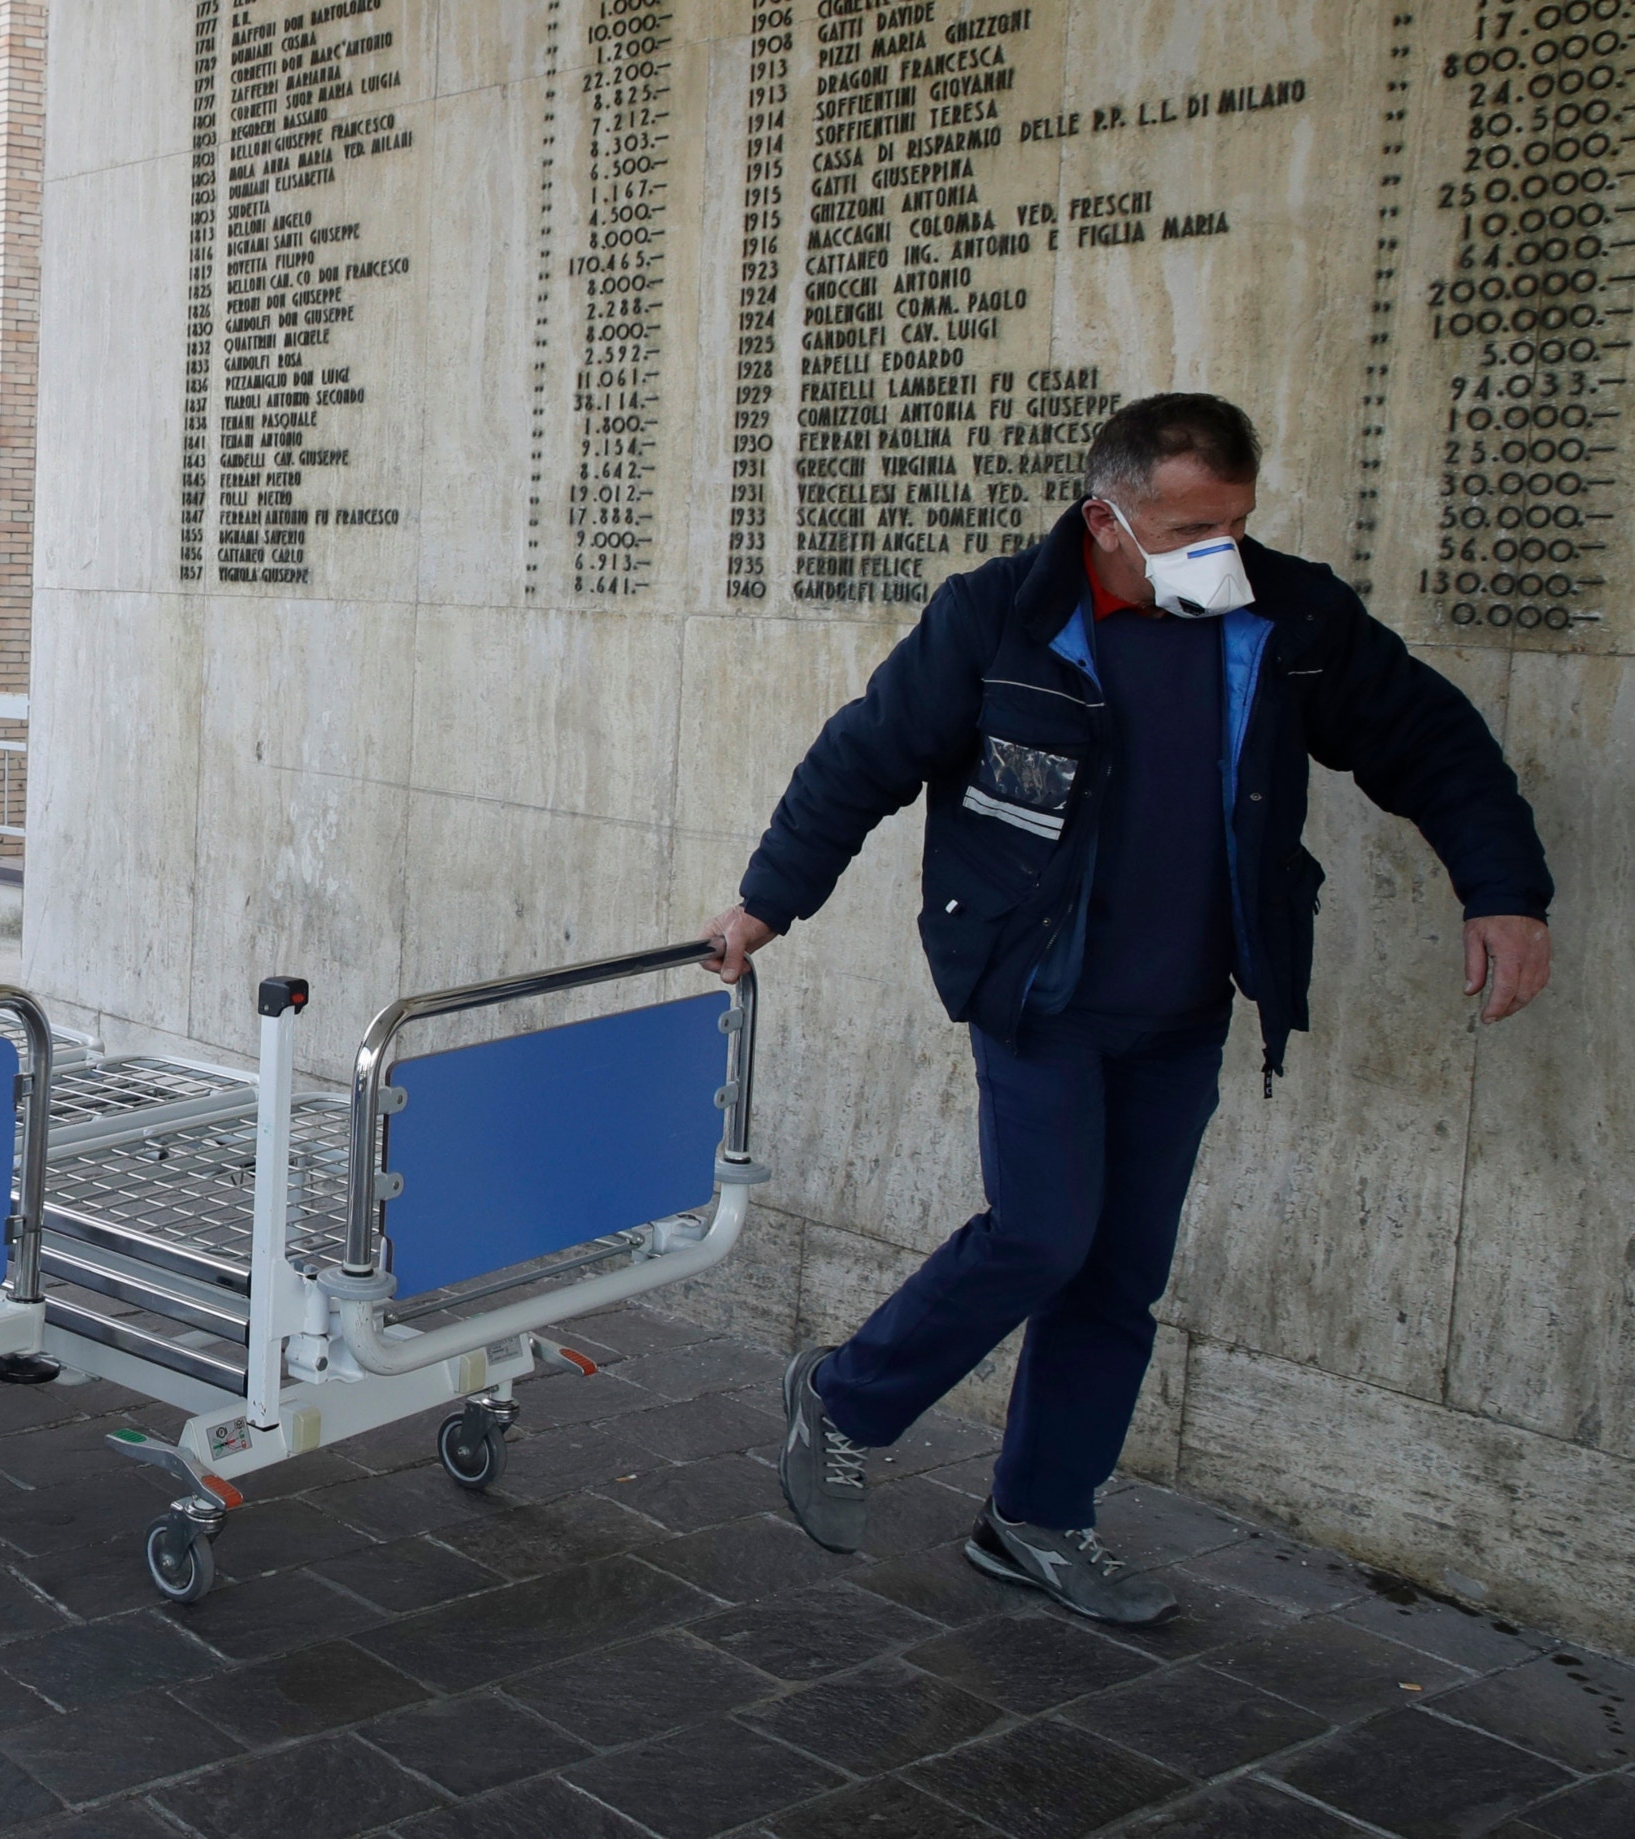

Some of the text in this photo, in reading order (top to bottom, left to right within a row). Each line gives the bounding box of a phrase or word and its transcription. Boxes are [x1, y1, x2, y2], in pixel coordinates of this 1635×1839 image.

[751, 2, 935, 58] 1908 GATTI DAVIDE
[752, 9, 793, 33] 1906
[750, 8, 1032, 82] 1913 PIZZI MARIA GHIZZONI
[749, 44, 1005, 108] 1913 DRAGONI FRANCESCA
[748, 67, 1014, 134] 1914 SOFFIENTINI GIOVANNI
[746, 159, 783, 183] 1915
[812, 148, 863, 173] CASSA
[878, 142, 894, 163] DI
[907, 125, 1002, 160] RISPARMIO
[1020, 113, 1080, 143] DELLE
[1187, 93, 1209, 119] DI
[1217, 78, 1306, 115] MILANO
[747, 99, 999, 159] 1914 SOFFIENTINI TERESA
[745, 157, 974, 207] 1915 GATTI GIUSEPPINA
[743, 190, 1153, 259] 1916 MACCAGNI COLOMBA VED. FRESCHI
[745, 183, 978, 232] 1915 GHIZZONI ANTONIA
[742, 211, 1230, 281] 1923 CATTANEO ING. ANTONIO E FIGLIA MARIA
[740, 266, 971, 307] 1924 GNOCCHI ANTONIO
[739, 288, 1027, 331] 1924 POLENGHI COMM. PAOLO
[738, 317, 998, 355] 1925 GANDOLFI CAV. LUIGI
[737, 347, 964, 380] 1928 RAPELLI EDOARDO
[736, 367, 1098, 405] 1929 FRATELLI LAMBERTI FU CESARI
[734, 393, 1122, 429] 1929 COMIZZOLI ANTONIA FU GIUSEPPE
[733, 422, 1104, 453] 1930 FERRARI PAOLINA FU FRANCESC
[732, 453, 1085, 478] 1931 GRECCHI VIRGINIA VED. RAPELL
[731, 484, 765, 503] 1931
[797, 483, 896, 505] VERCELLESI
[906, 483, 972, 503] EMILIA
[988, 483, 1029, 503] VED.
[731, 507, 1022, 527] 1933 SCACCHI AVV. DOMENICO
[729, 532, 765, 551] 1933
[797, 532, 875, 552] RAZZETTI
[882, 532, 949, 553] ANGELA
[965, 533, 988, 553] FU
[728, 557, 922, 578] 1935 PERONI FELICE
[727, 580, 927, 602] 1940 GANDOLFI LUIGI
